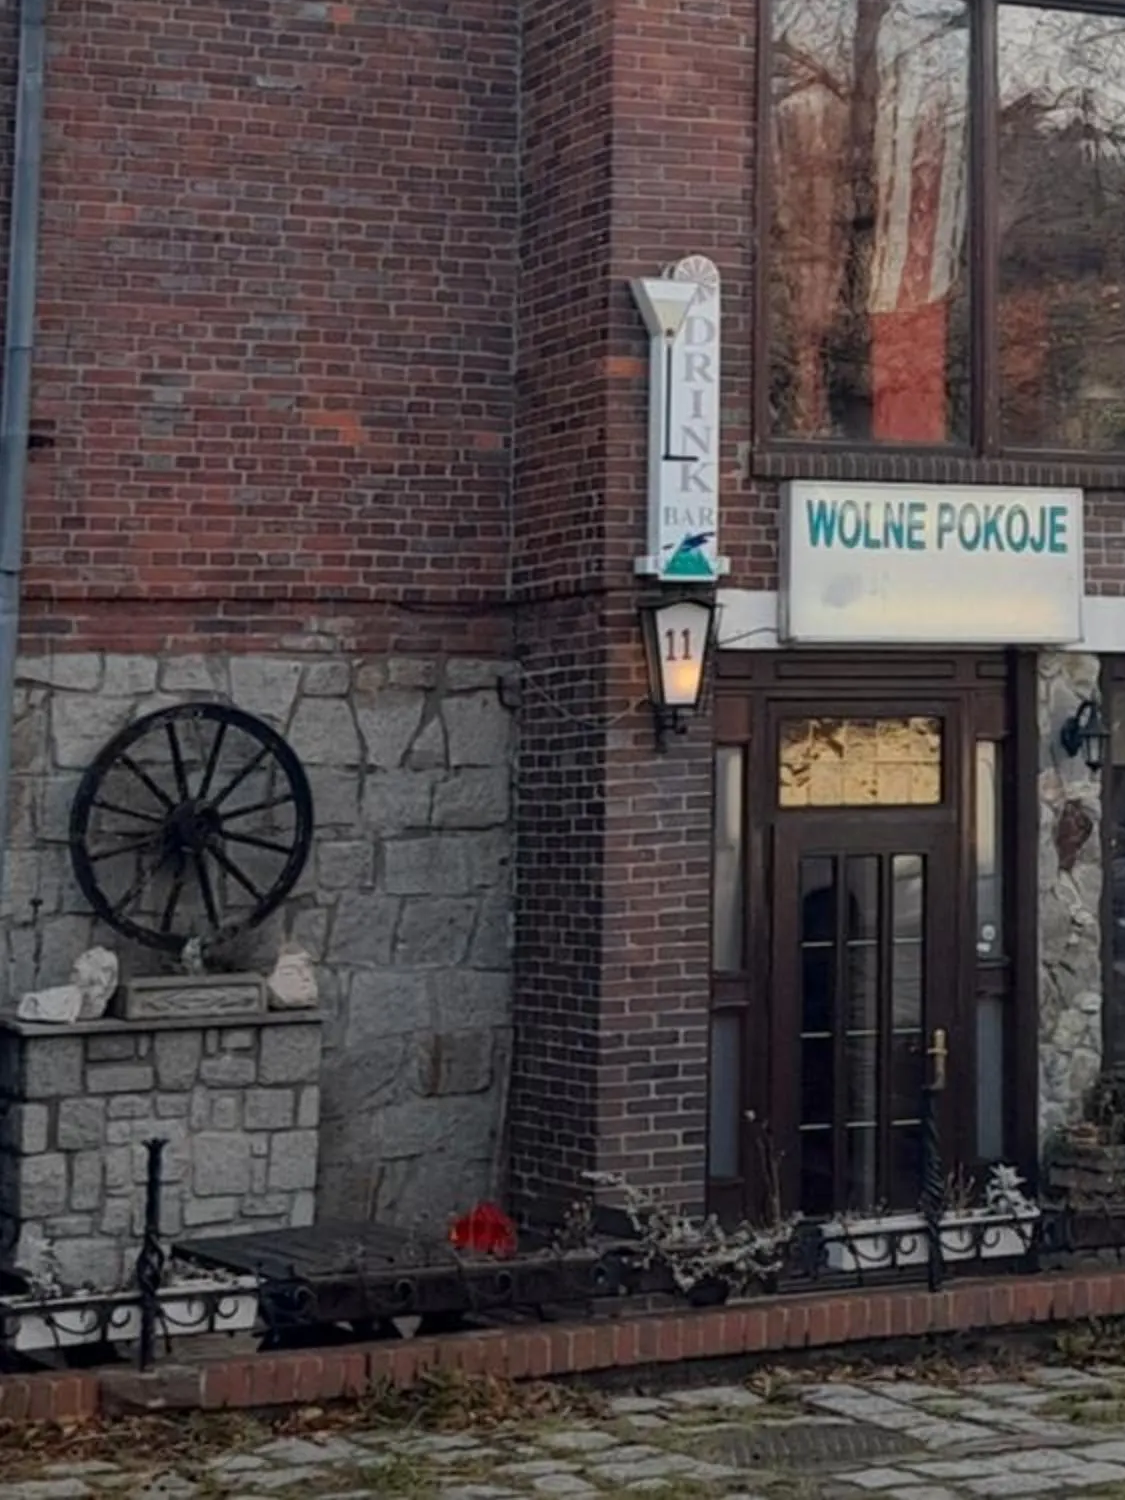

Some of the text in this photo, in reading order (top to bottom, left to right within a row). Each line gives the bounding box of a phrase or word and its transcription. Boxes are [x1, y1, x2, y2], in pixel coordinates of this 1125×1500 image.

[679, 315, 716, 494] DRINK
[663, 505, 715, 527] BAR
[806, 499, 1068, 553] WOLNE POKOJE
[664, 627, 693, 662] 11
